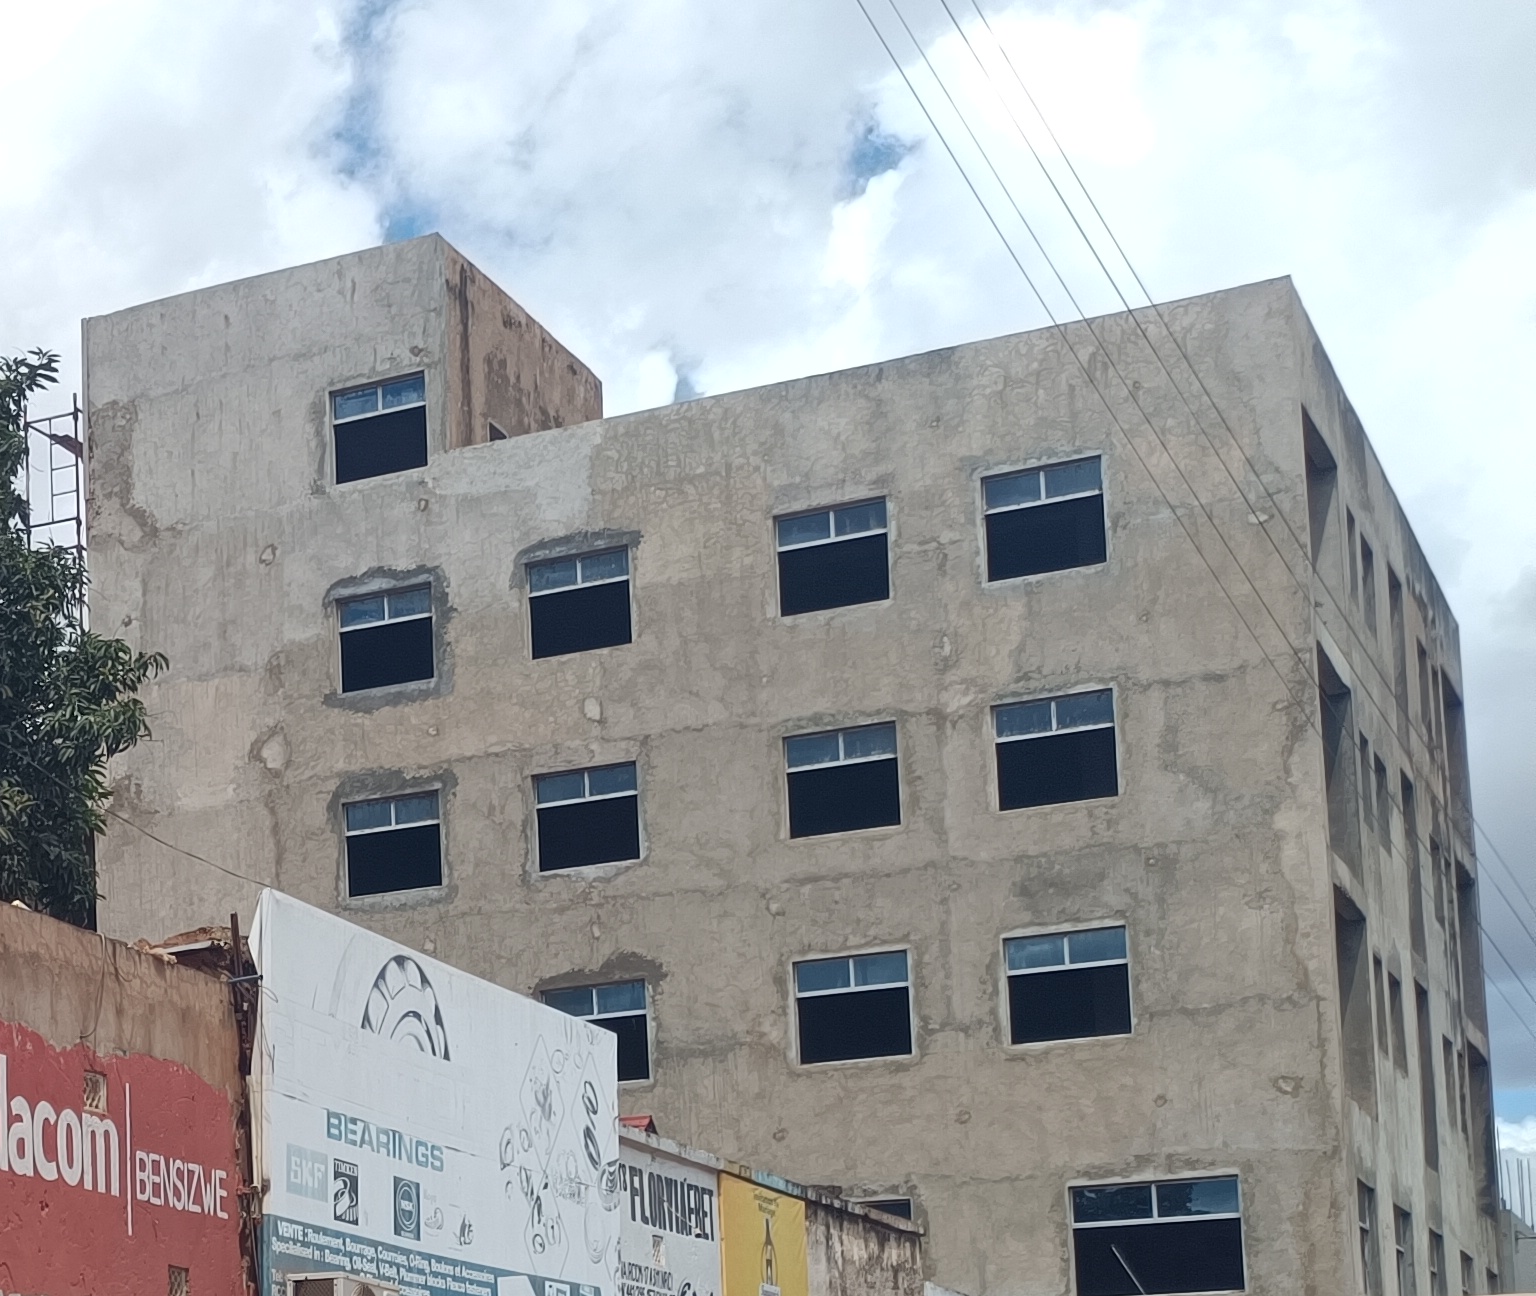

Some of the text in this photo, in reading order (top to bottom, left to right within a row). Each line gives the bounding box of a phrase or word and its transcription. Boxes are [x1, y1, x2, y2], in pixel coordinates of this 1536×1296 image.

[289, 1156, 326, 1190] SKF
[326, 1108, 445, 1173] BEARINGS
[135, 1150, 228, 1220] BENSIZWE
